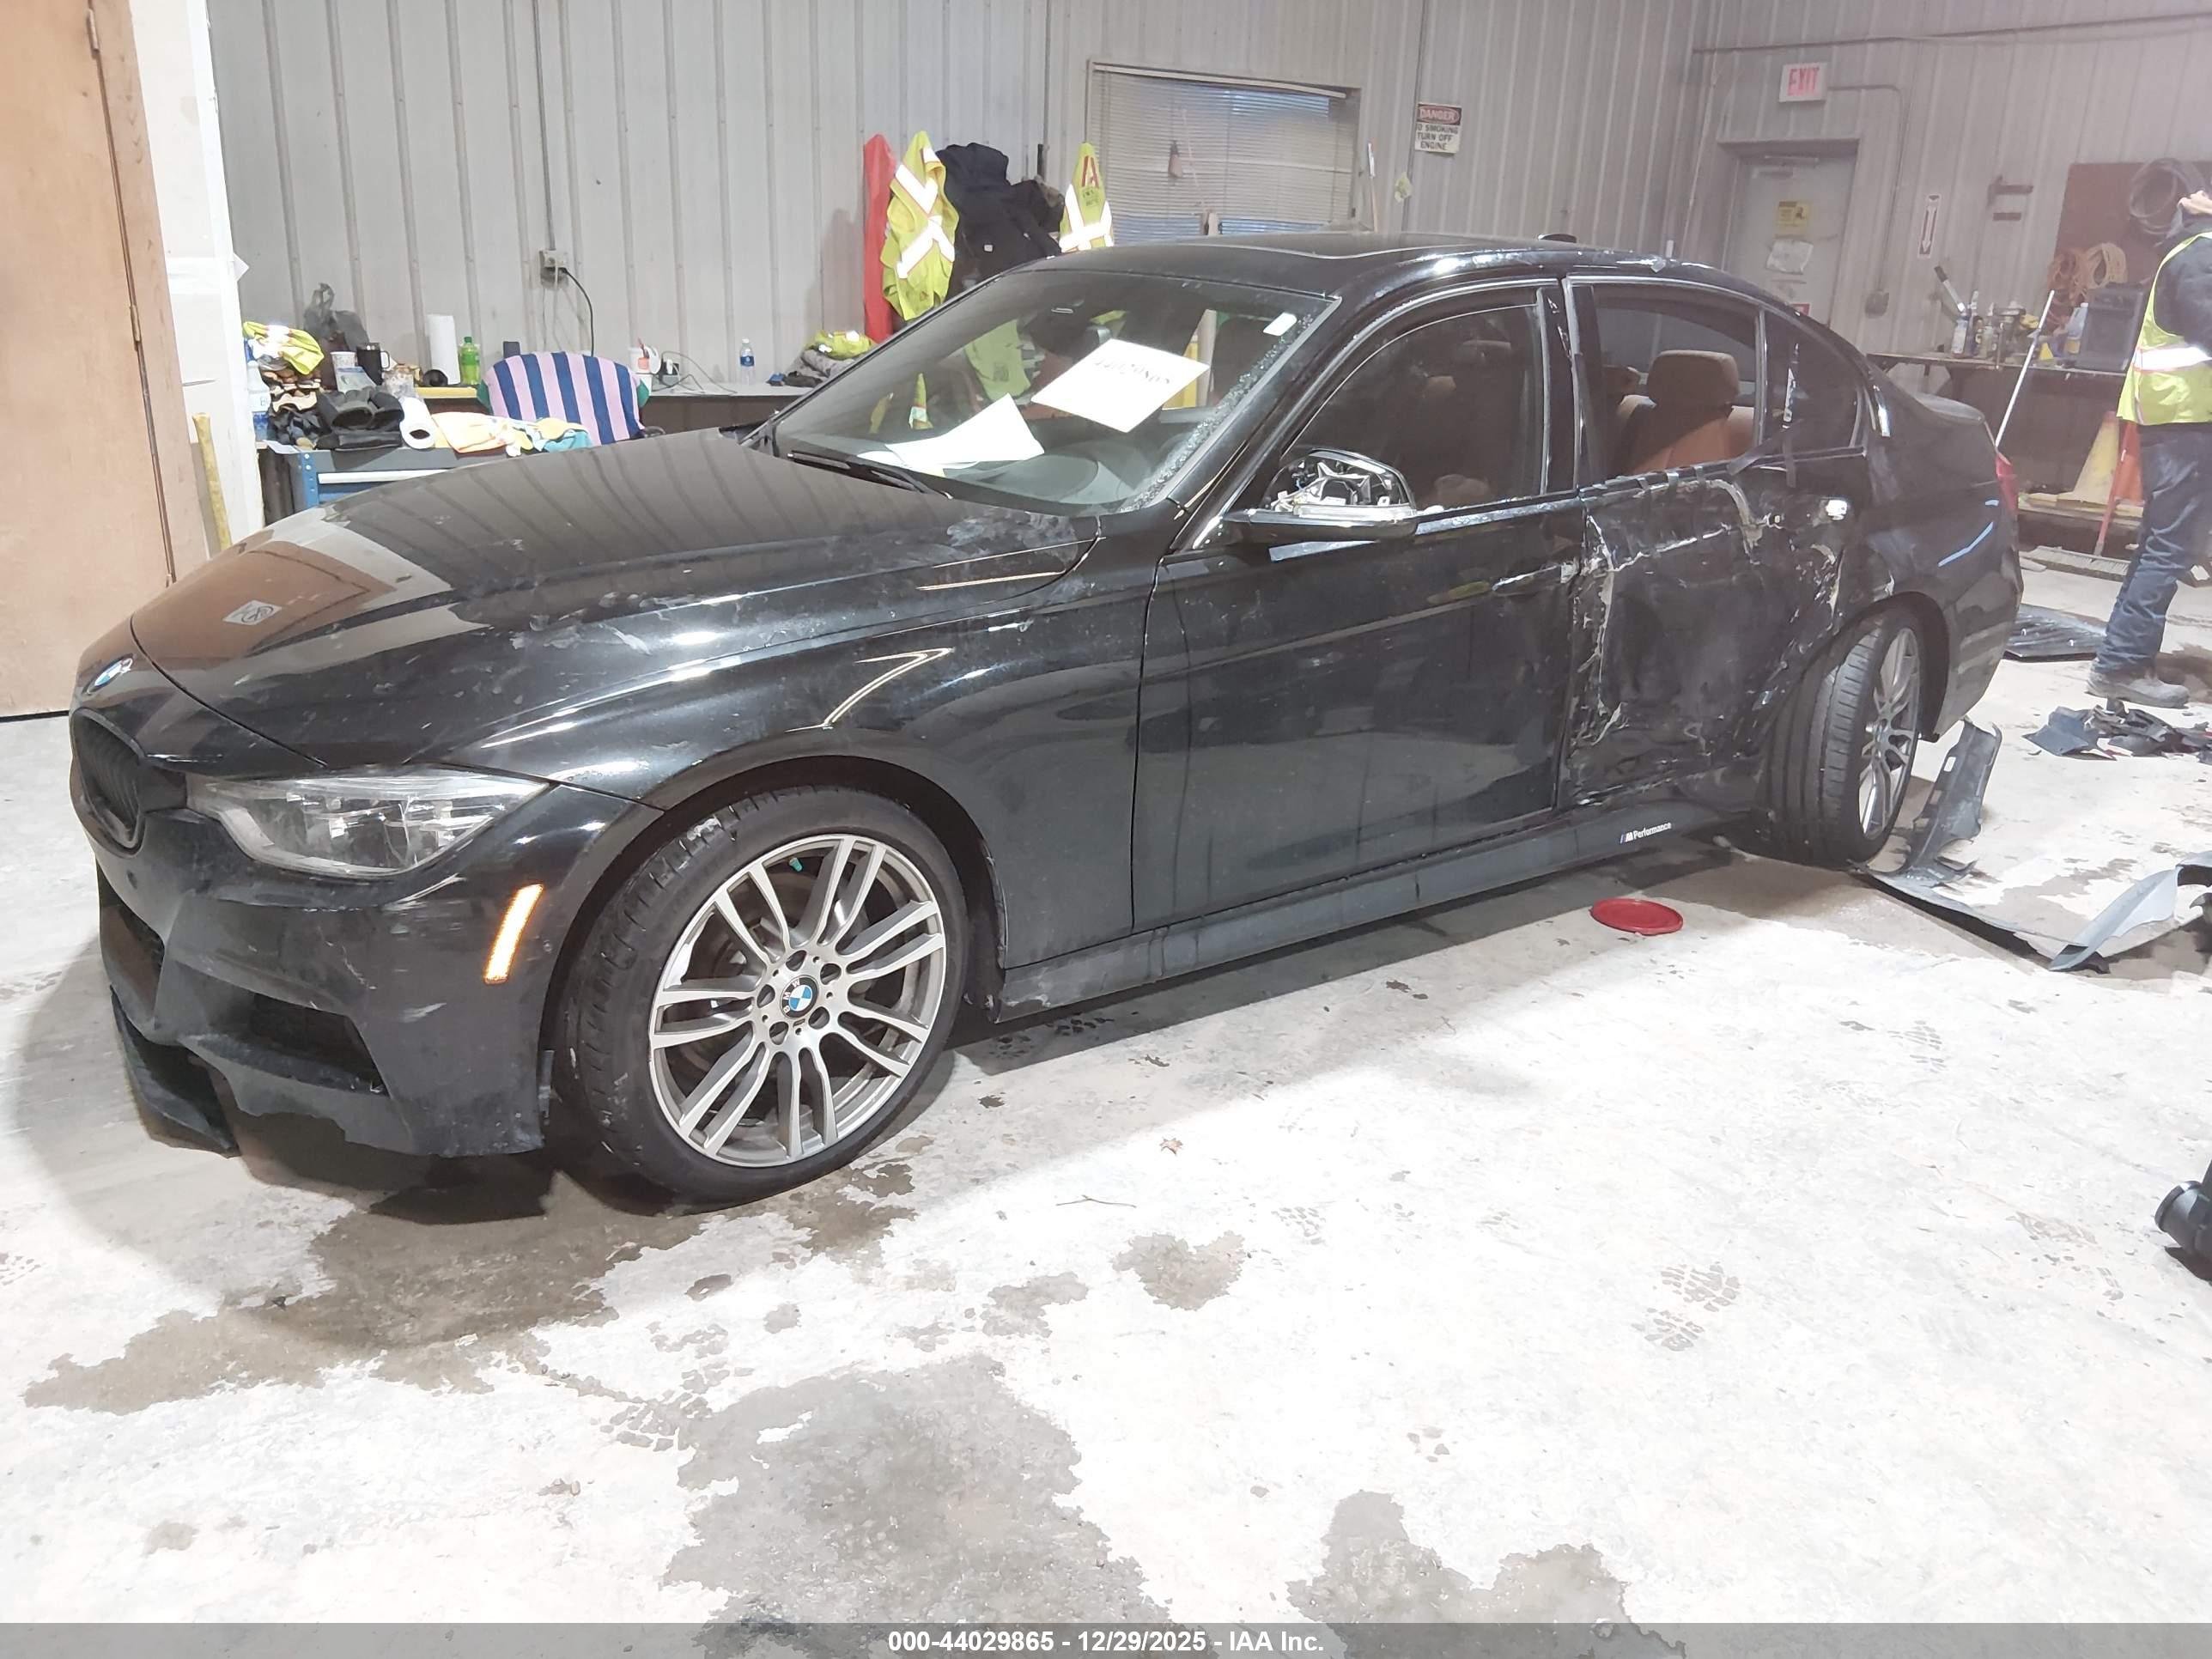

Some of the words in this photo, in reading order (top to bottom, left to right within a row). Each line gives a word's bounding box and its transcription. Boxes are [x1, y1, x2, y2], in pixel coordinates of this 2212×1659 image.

[1788, 67, 1820, 96] EXIT
[1419, 108, 1456, 121] DANGER
[1425, 125, 1458, 135] SMOKING
[1418, 132, 1436, 141] TURN
[1438, 134, 1453, 143] OFF
[1420, 141, 1448, 151] ENGINE
[1633, 822, 1672, 840] Performance
[782, 979, 800, 1014] BMW
